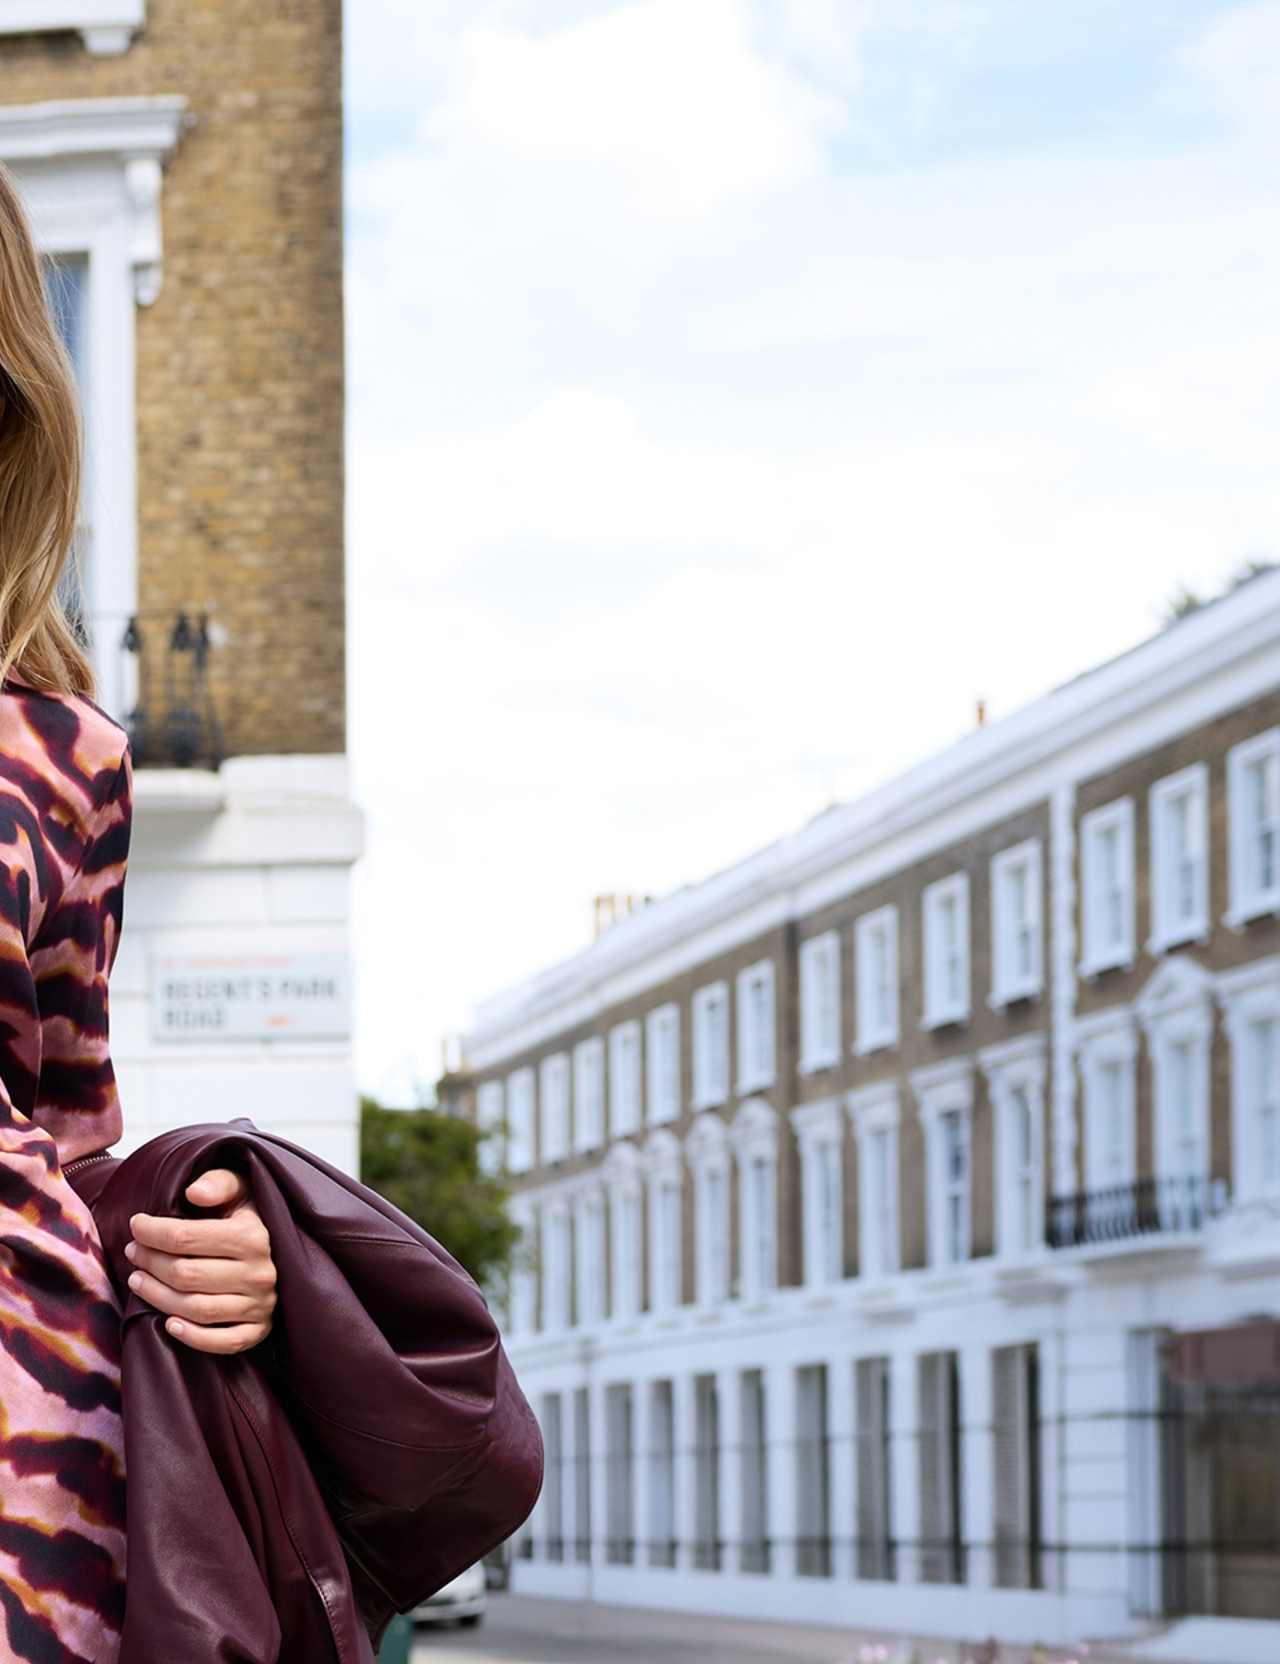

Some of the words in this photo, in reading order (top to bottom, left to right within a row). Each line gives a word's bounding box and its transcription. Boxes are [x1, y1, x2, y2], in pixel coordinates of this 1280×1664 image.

[164, 977, 271, 999] REGENTS
[280, 977, 337, 999] PARK
[164, 1007, 223, 1028] ROAD
